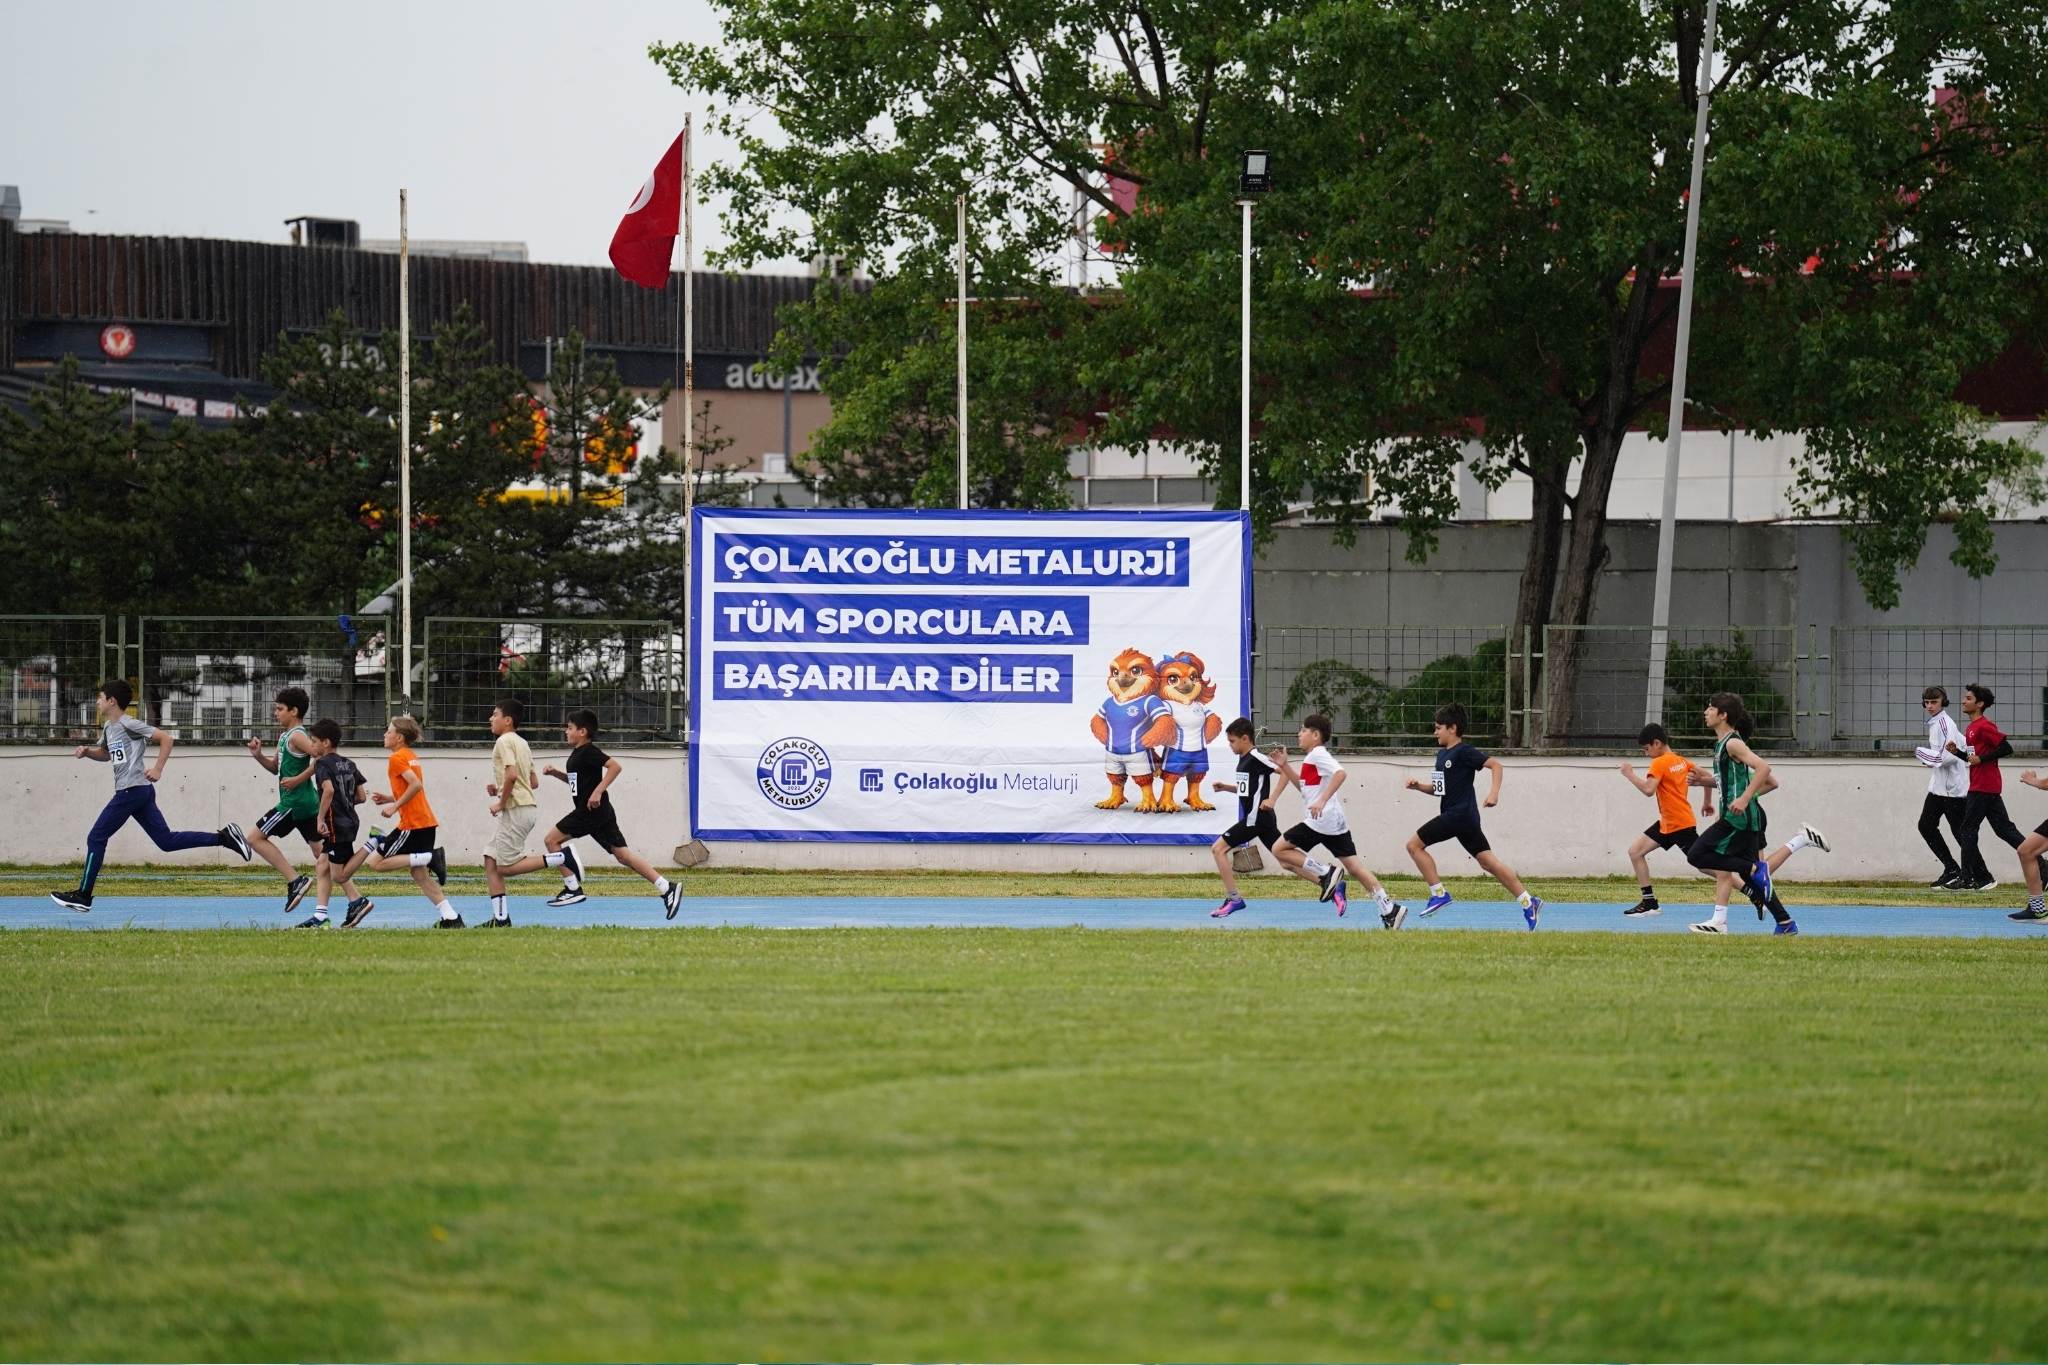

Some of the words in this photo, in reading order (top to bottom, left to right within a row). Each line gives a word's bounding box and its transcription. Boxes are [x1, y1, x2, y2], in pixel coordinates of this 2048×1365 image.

[724, 540, 955, 580] ÇOLAKOĞLU
[967, 540, 1176, 576] METALURJİ
[723, 599, 805, 634] TÜM
[815, 607, 1074, 636] SPORCULARA
[724, 663, 940, 698] BAŞARILAR
[950, 656, 1060, 693] DİLER
[764, 741, 826, 766] ÇOLAKOĞLU
[762, 779, 816, 806] METALURJİ
[814, 780, 826, 794] SK
[894, 772, 998, 795] Çolakoğlu
[1003, 772, 1078, 795] Metalurji
